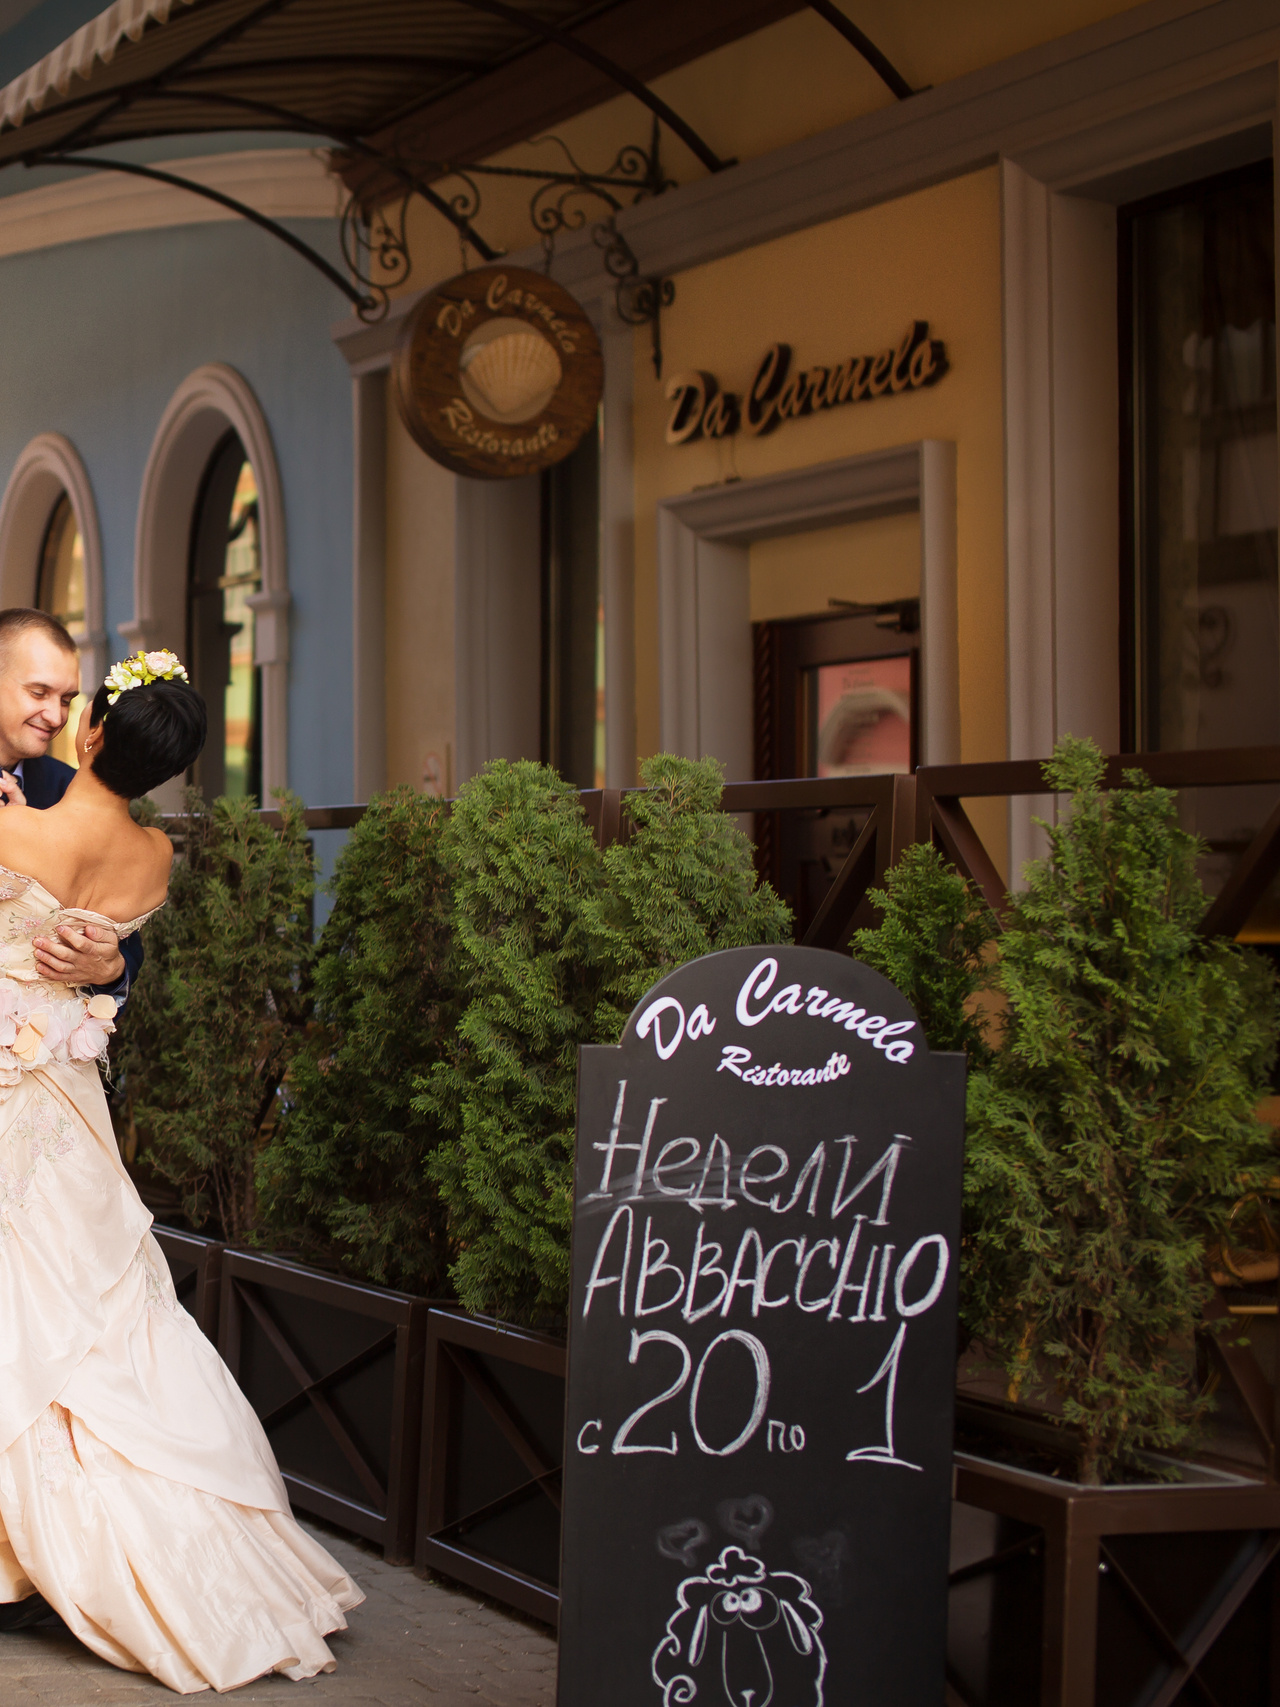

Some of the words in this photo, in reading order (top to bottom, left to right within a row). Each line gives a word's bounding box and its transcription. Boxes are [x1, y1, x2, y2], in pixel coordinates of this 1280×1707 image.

[436, 299, 476, 338] Da
[486, 274, 580, 354] Carmelo
[440, 398, 559, 456] Ristorante
[665, 370, 738, 445] Da
[741, 320, 949, 437] Carmelo
[635, 996, 717, 1061] Da
[735, 957, 916, 1065] Carmelo
[716, 1045, 851, 1087] Ristorante
[586, 1079, 912, 1226] Недели
[612, 1328, 771, 1456] 20
[845, 1321, 924, 1471] 1
